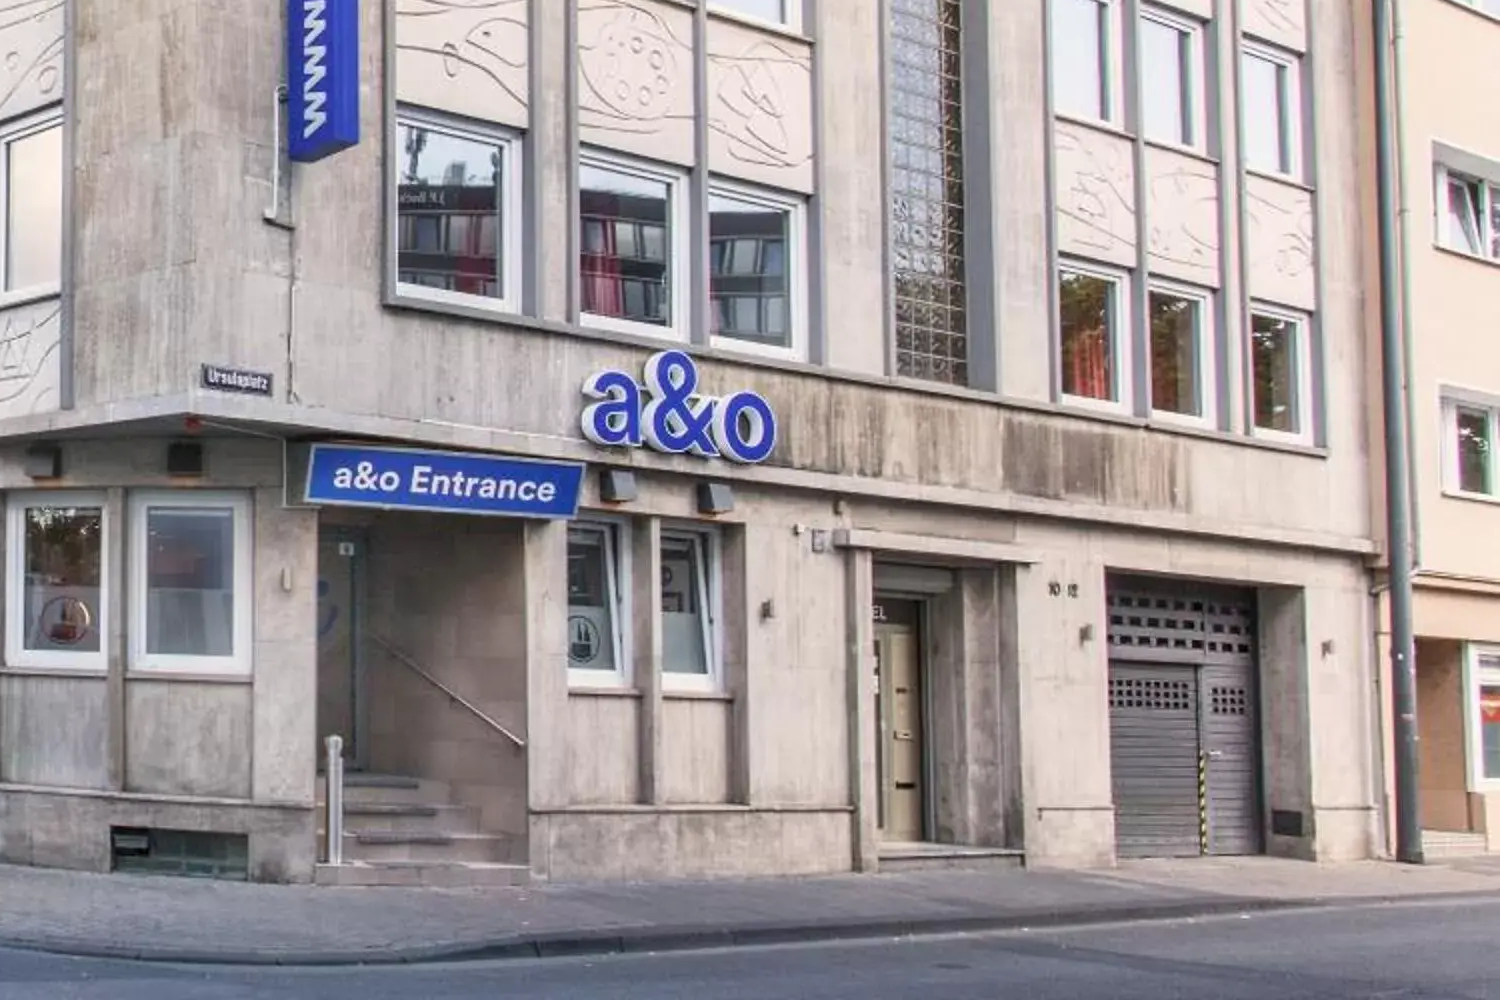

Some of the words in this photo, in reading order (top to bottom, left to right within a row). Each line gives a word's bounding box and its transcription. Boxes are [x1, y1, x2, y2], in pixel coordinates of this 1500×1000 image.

[582, 350, 777, 463] a&o
[333, 461, 401, 493] a&o
[410, 465, 556, 503] Entrance
